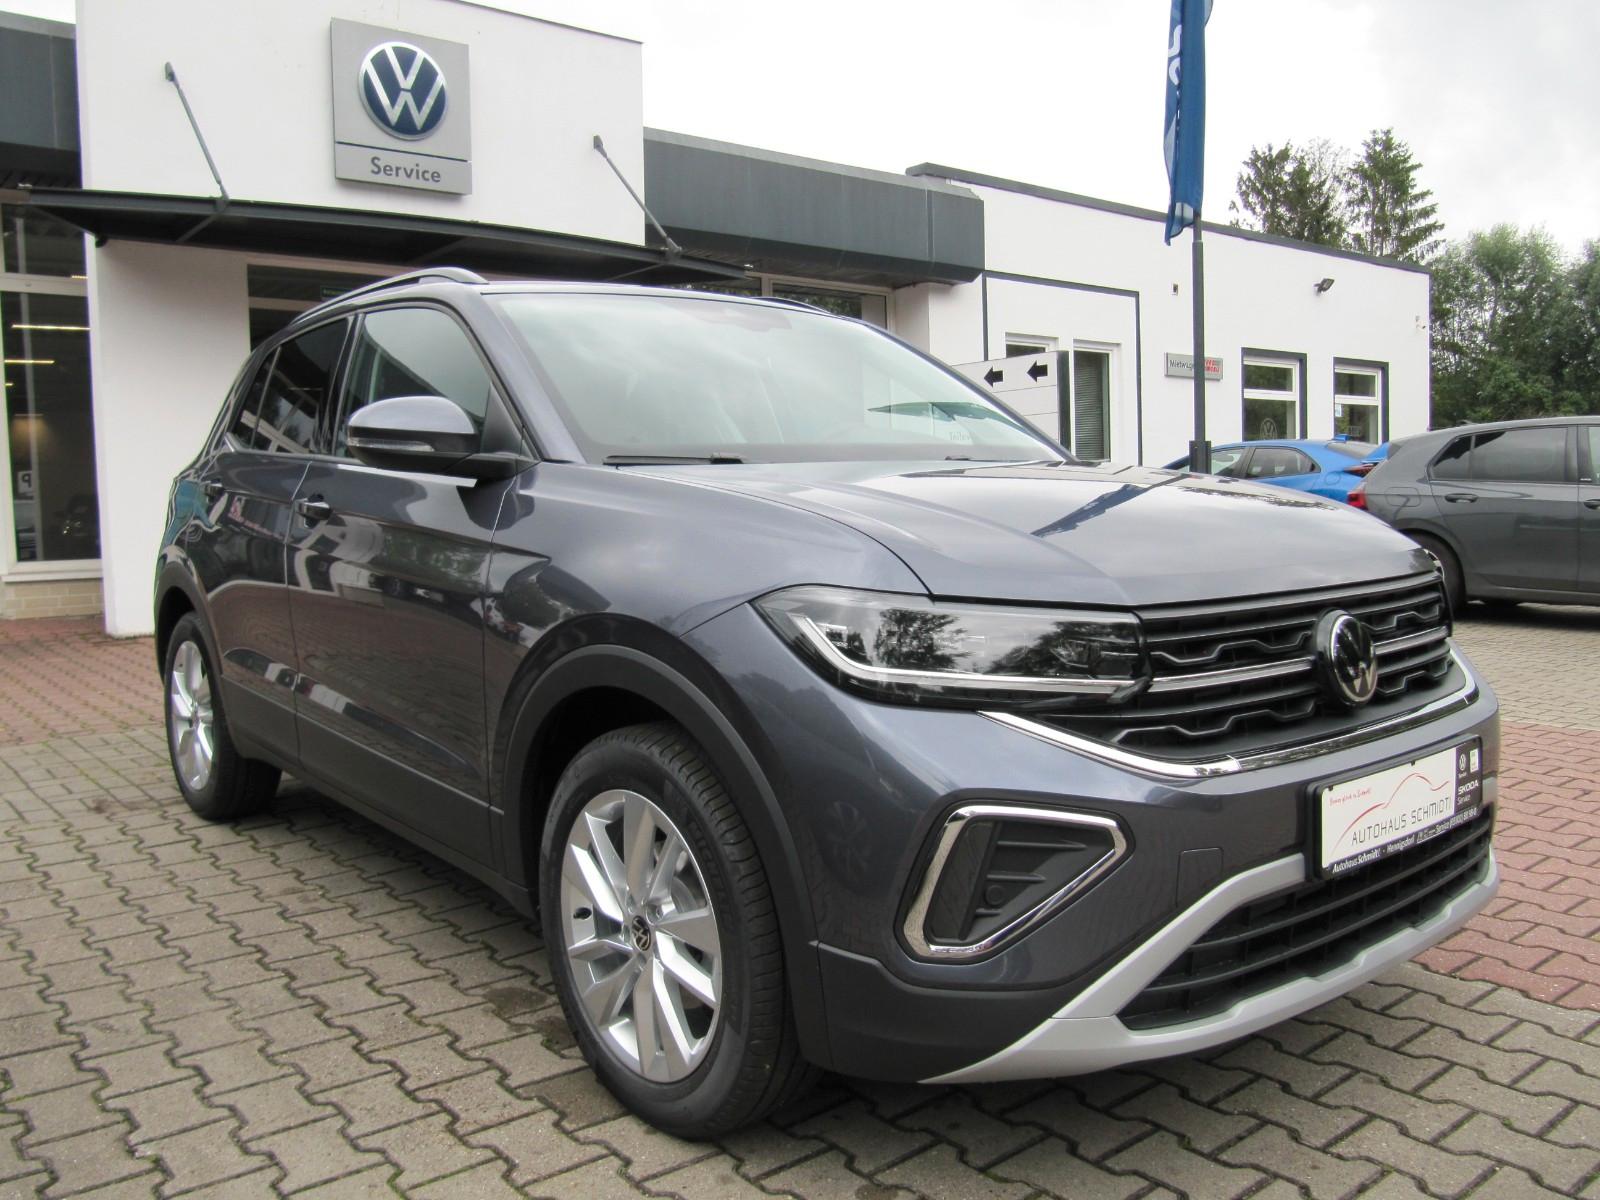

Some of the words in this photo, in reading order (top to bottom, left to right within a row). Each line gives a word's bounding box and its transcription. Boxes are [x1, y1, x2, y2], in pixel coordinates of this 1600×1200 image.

[359, 42, 448, 141] VW
[371, 156, 441, 183] Service
[1352, 814, 1407, 846] AUTOHAUS
[1411, 797, 1449, 825] SCHMIDT
[1332, 857, 1358, 874] Autohaus
